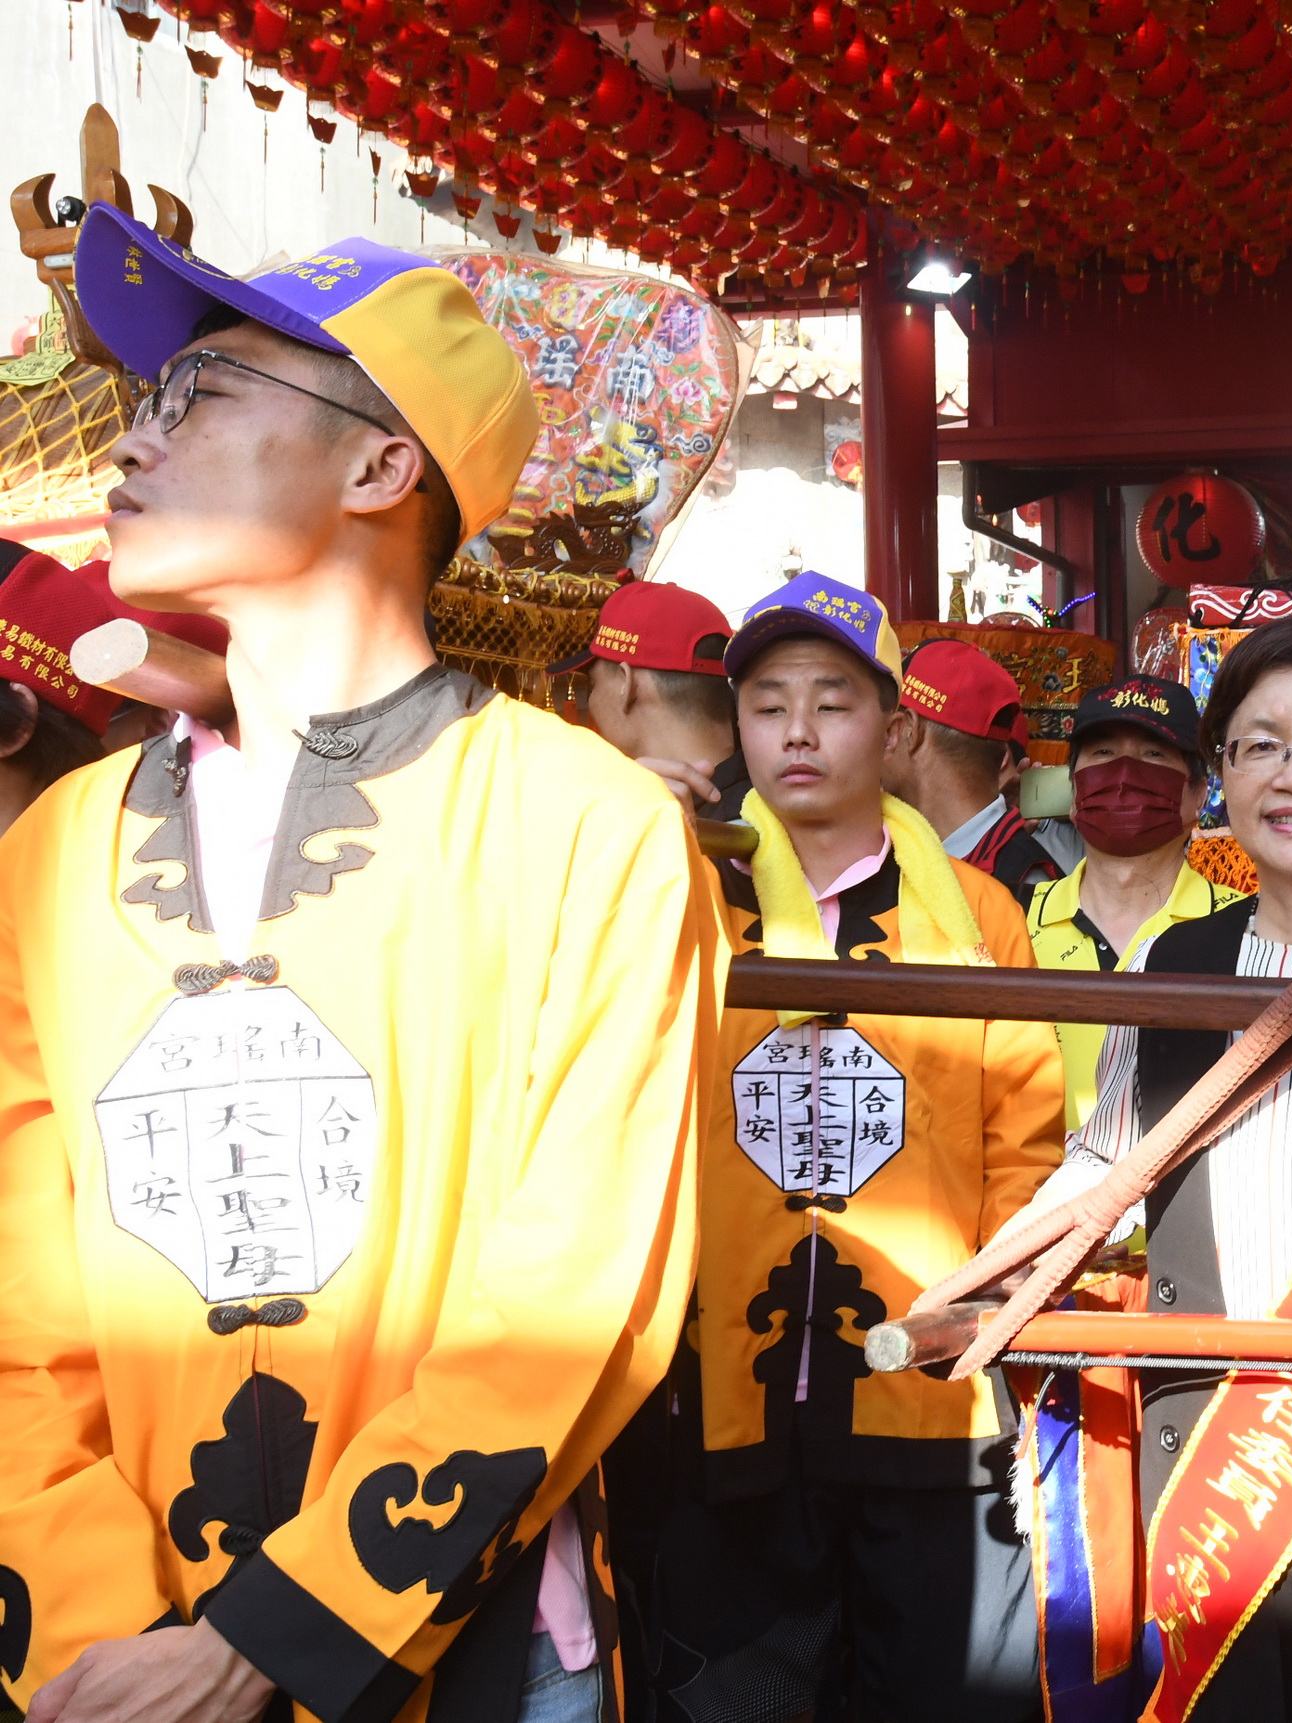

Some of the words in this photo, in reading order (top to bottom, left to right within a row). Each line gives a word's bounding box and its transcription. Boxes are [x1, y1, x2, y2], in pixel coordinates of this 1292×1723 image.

[1153, 492, 1222, 562] 化
[1060, 945, 1079, 962] FILA
[149, 1021, 321, 1074] 南瑤宮
[762, 1040, 873, 1069] 南瑤宮
[741, 1080, 777, 1144] 平安
[786, 1083, 849, 1186] 天上聖母
[858, 1085, 896, 1147] 合境
[121, 1108, 183, 1220] 平安
[315, 1095, 365, 1204] 合境
[204, 1100, 304, 1288] 天上聖母
